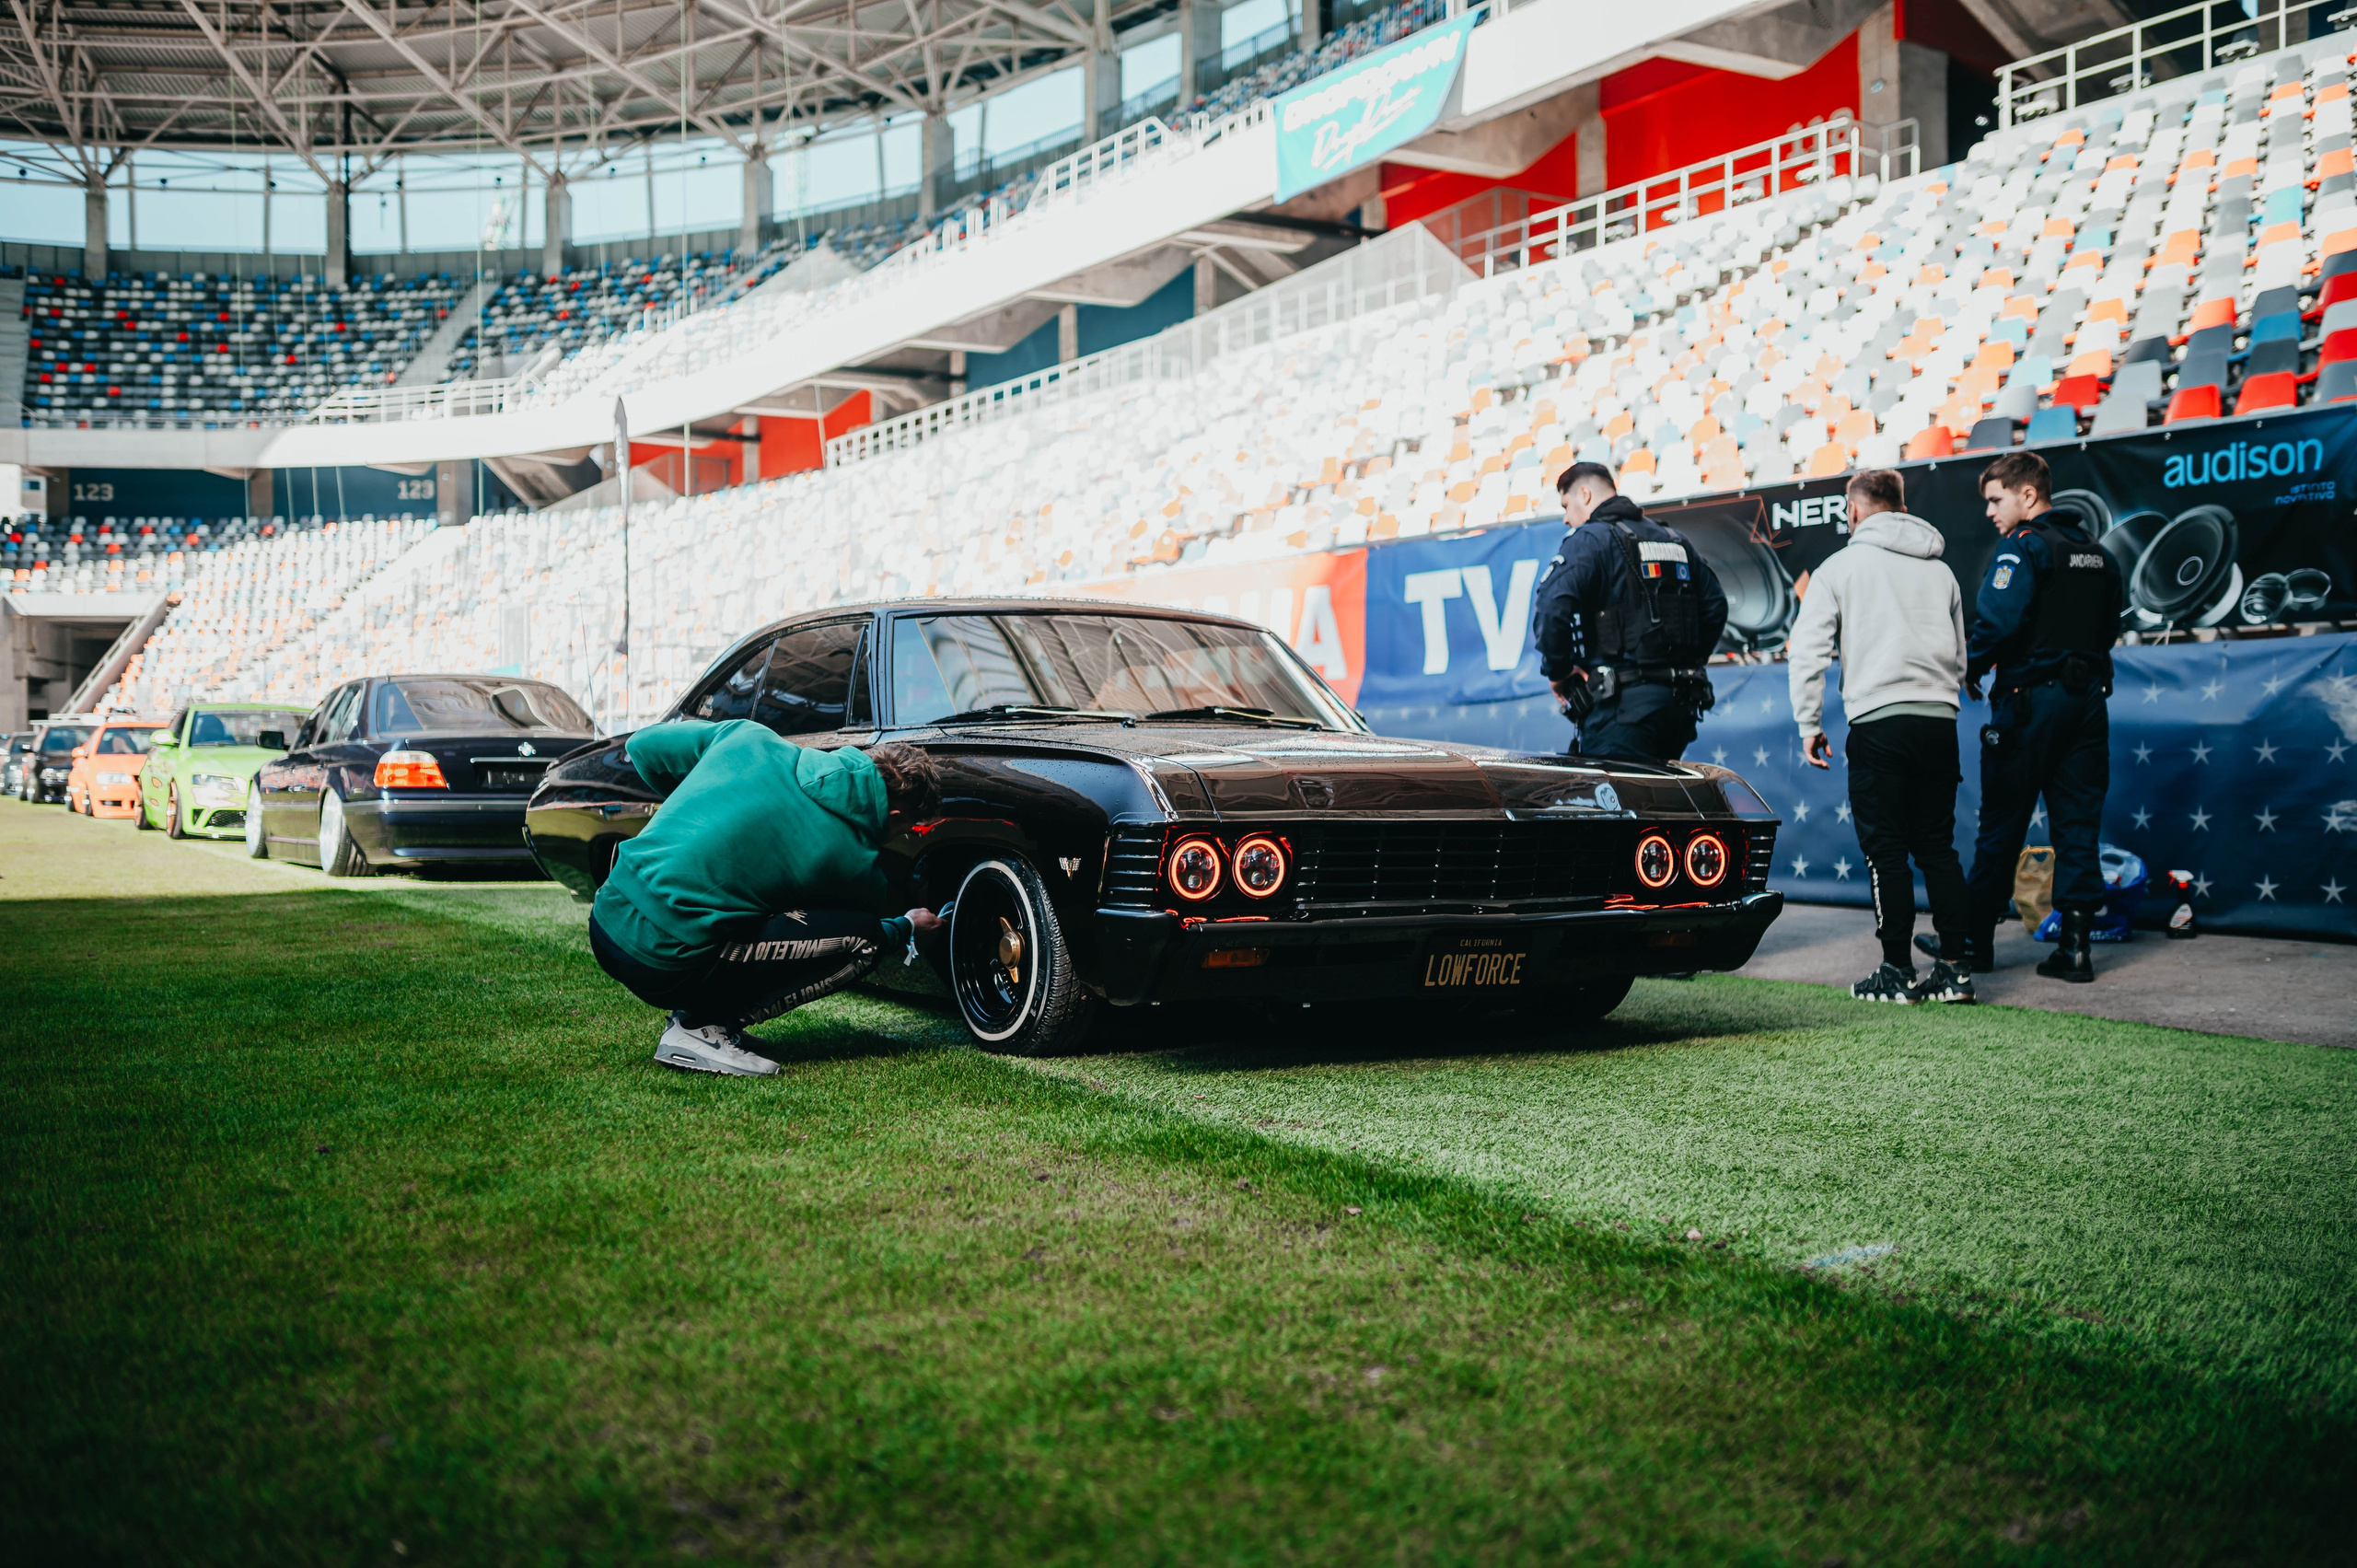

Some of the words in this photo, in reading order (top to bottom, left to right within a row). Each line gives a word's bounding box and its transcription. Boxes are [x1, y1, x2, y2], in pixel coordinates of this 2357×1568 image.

[2163, 437, 2324, 489] audison
[75, 483, 113, 501] 123
[398, 479, 435, 500] 123
[1771, 494, 1848, 530] NER
[1404, 559, 1538, 675] TV
[1459, 938, 1503, 947] CALIFORNIA
[1424, 953, 1526, 986] LOWFORCE
